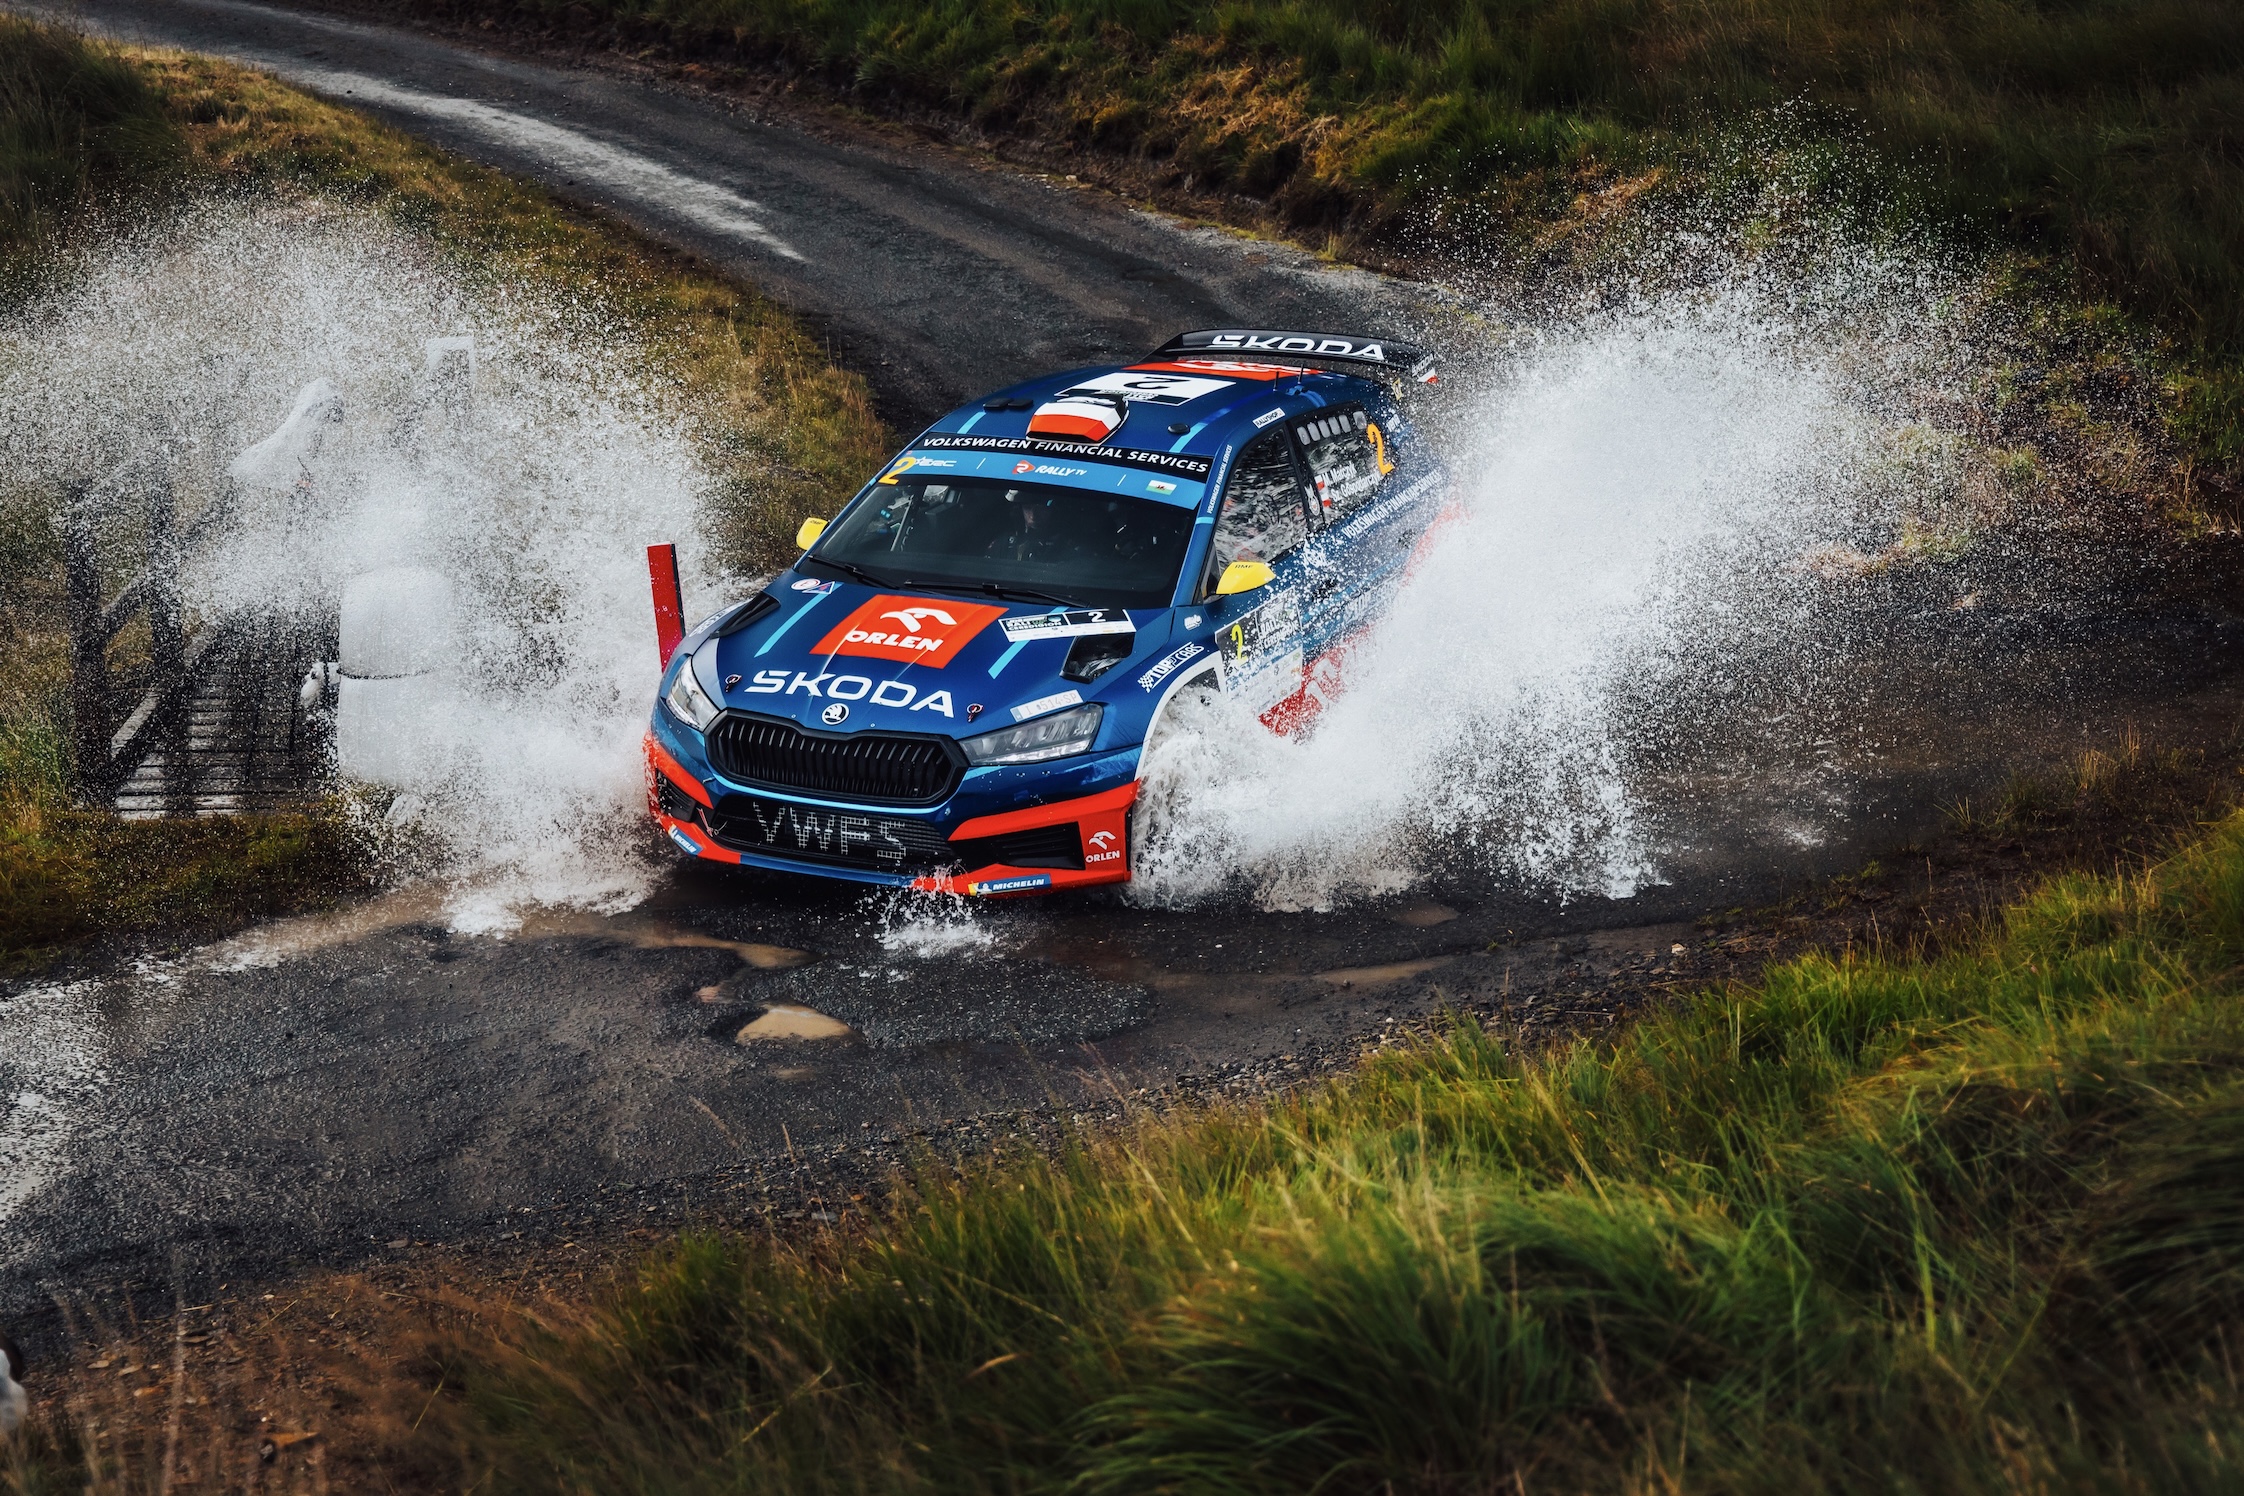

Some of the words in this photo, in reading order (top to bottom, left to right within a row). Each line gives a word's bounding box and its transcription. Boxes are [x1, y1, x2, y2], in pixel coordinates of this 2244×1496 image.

[1123, 376, 1191, 389] 2
[923, 437, 1031, 449] VOLKSWAGEN
[1035, 441, 1123, 458] FINANCIAL
[1127, 451, 1209, 473] SERVICES
[1366, 423, 1394, 475] 2
[878, 456, 917, 485] 2
[1341, 502, 1389, 539] VOLKSWAGEN
[1088, 611, 1106, 623] 2
[845, 630, 943, 651] ORLEN
[1231, 624, 1247, 662] 2
[674, 832, 697, 853] MICHELIN
[753, 801, 906, 859] VWFS
[1085, 850, 1120, 863] ORLEN
[993, 878, 1045, 891] MICHELIN
